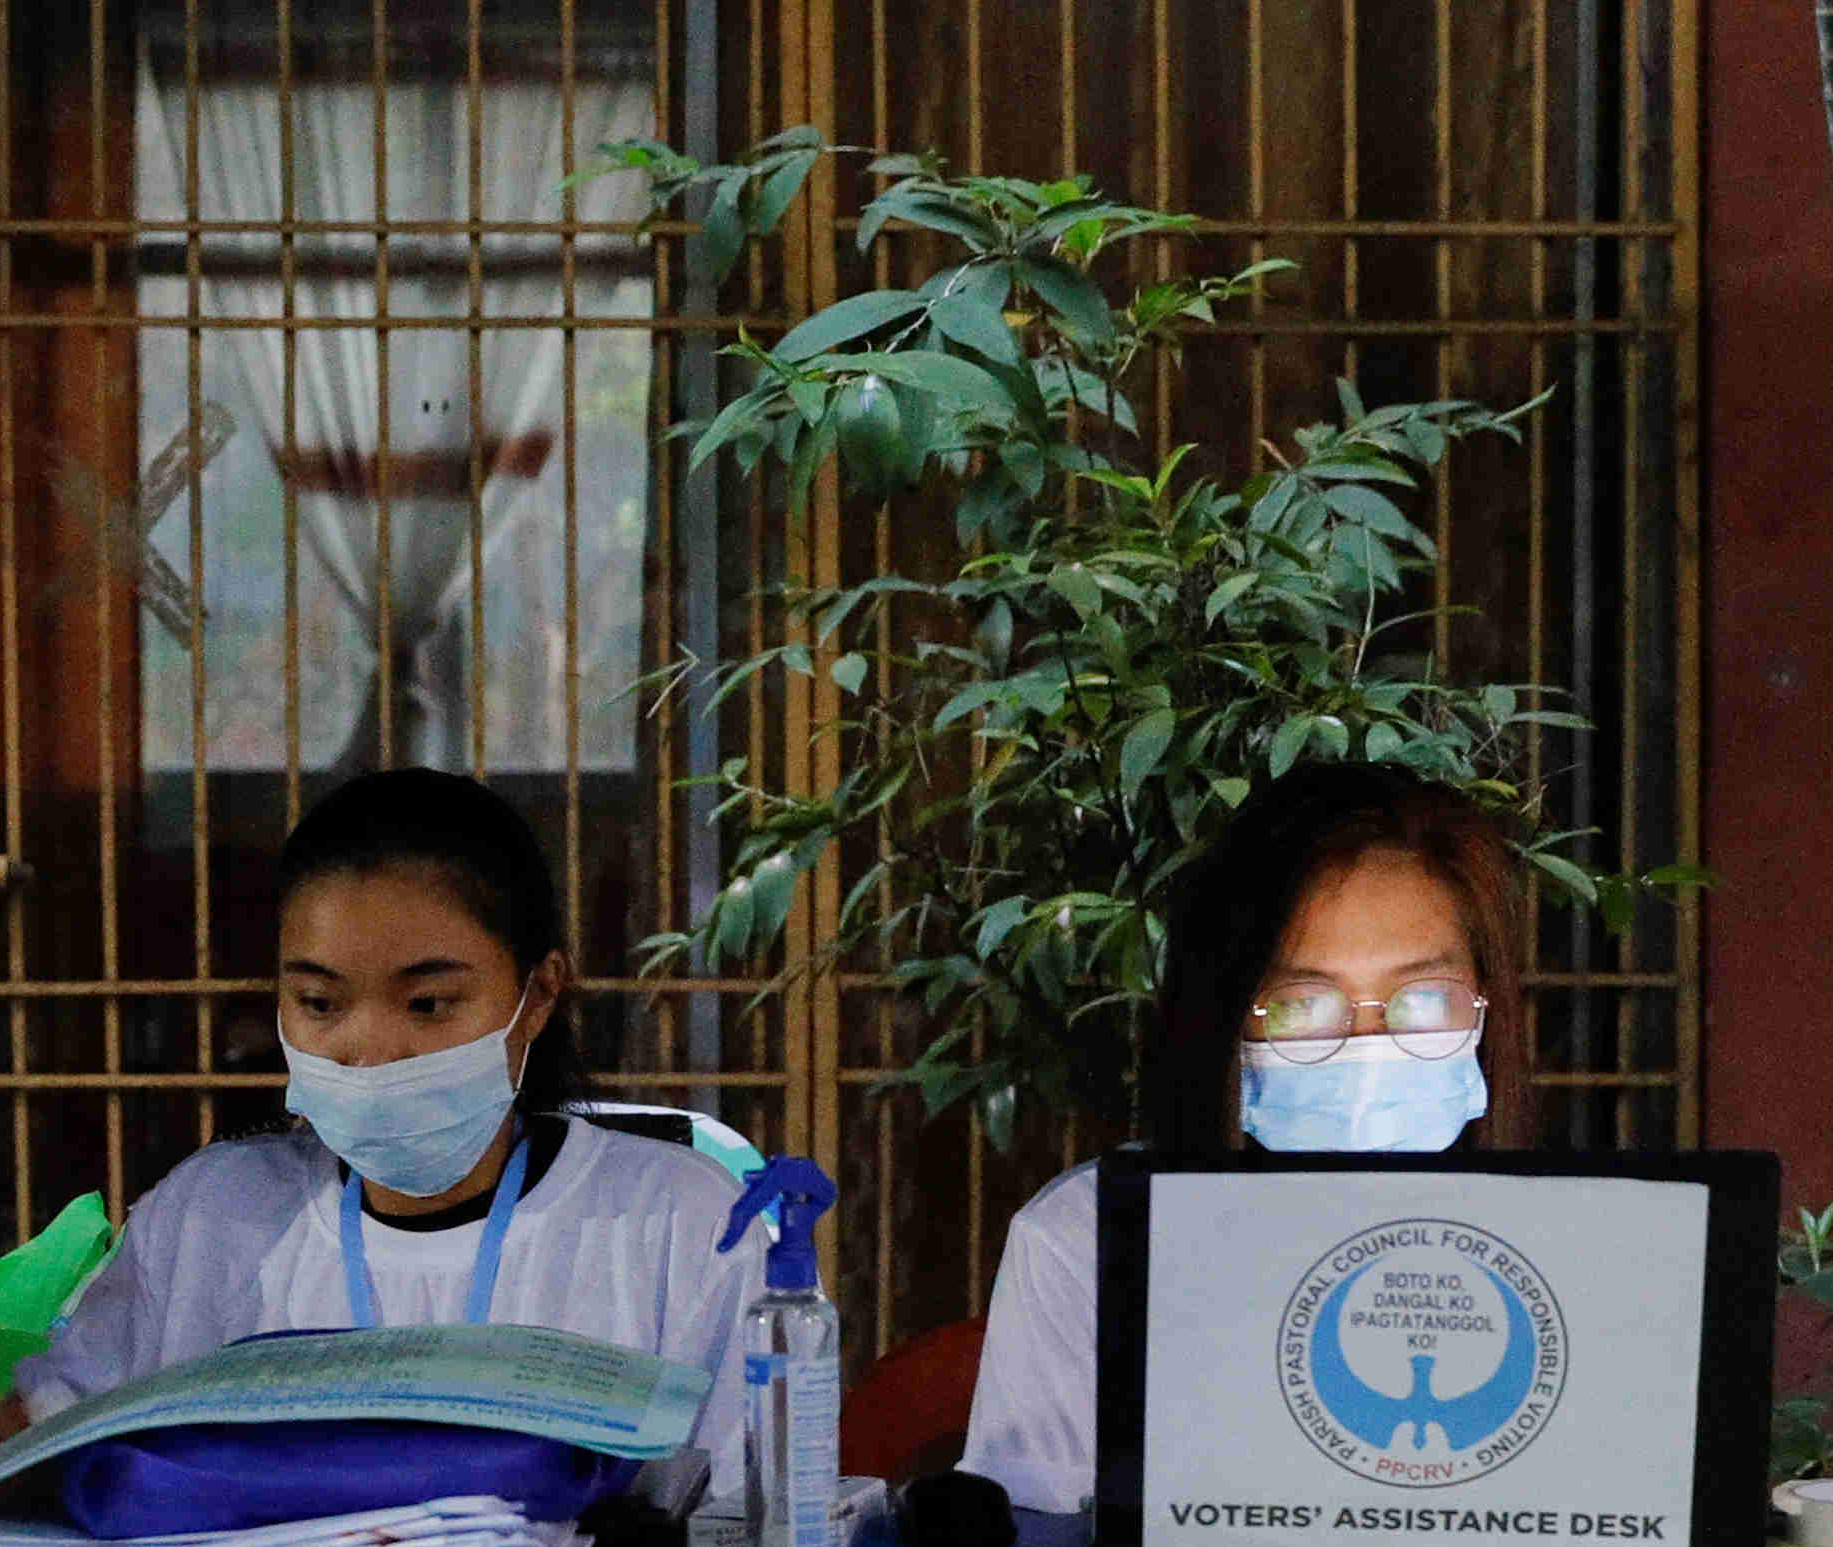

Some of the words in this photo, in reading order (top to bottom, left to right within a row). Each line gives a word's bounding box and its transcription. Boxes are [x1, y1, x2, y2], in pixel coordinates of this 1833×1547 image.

[1332, 1229, 1433, 1273] COUNCIL
[1441, 1230, 1490, 1261] FOR
[1383, 1272, 1431, 1289] BOTO
[1373, 1292, 1444, 1310] DANGAL
[1449, 1294, 1474, 1311] KO
[1286, 1276, 1335, 1387] PASTORAL
[1350, 1311, 1495, 1332] IPAGTATANGGOL
[1490, 1251, 1558, 1397] RESPONSIBLE
[1407, 1333, 1438, 1350] KO!
[1293, 1391, 1357, 1461] PARISH
[1476, 1401, 1545, 1467] VOTING
[1375, 1456, 1454, 1481] PPCRV
[1169, 1502, 1323, 1529] VOTERS’
[1333, 1507, 1559, 1536] ASSISTANCE
[1569, 1513, 1665, 1540] DESK
